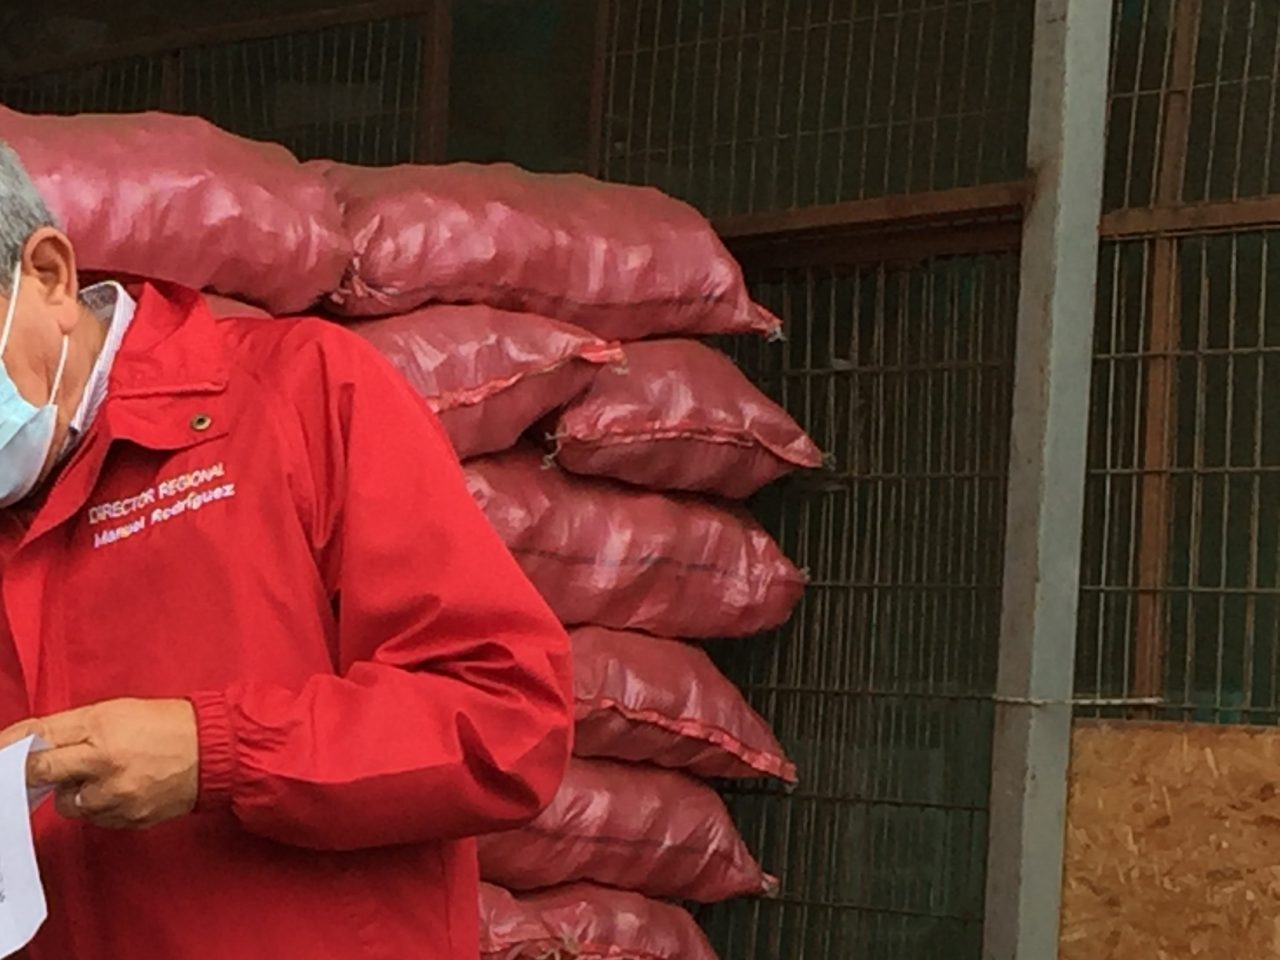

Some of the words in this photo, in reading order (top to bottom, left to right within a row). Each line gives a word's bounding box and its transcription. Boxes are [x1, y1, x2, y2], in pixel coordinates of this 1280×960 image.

[89, 487, 156, 524] DIRECTOR
[158, 462, 224, 499] REGIONAL
[93, 516, 145, 548] Manuel
